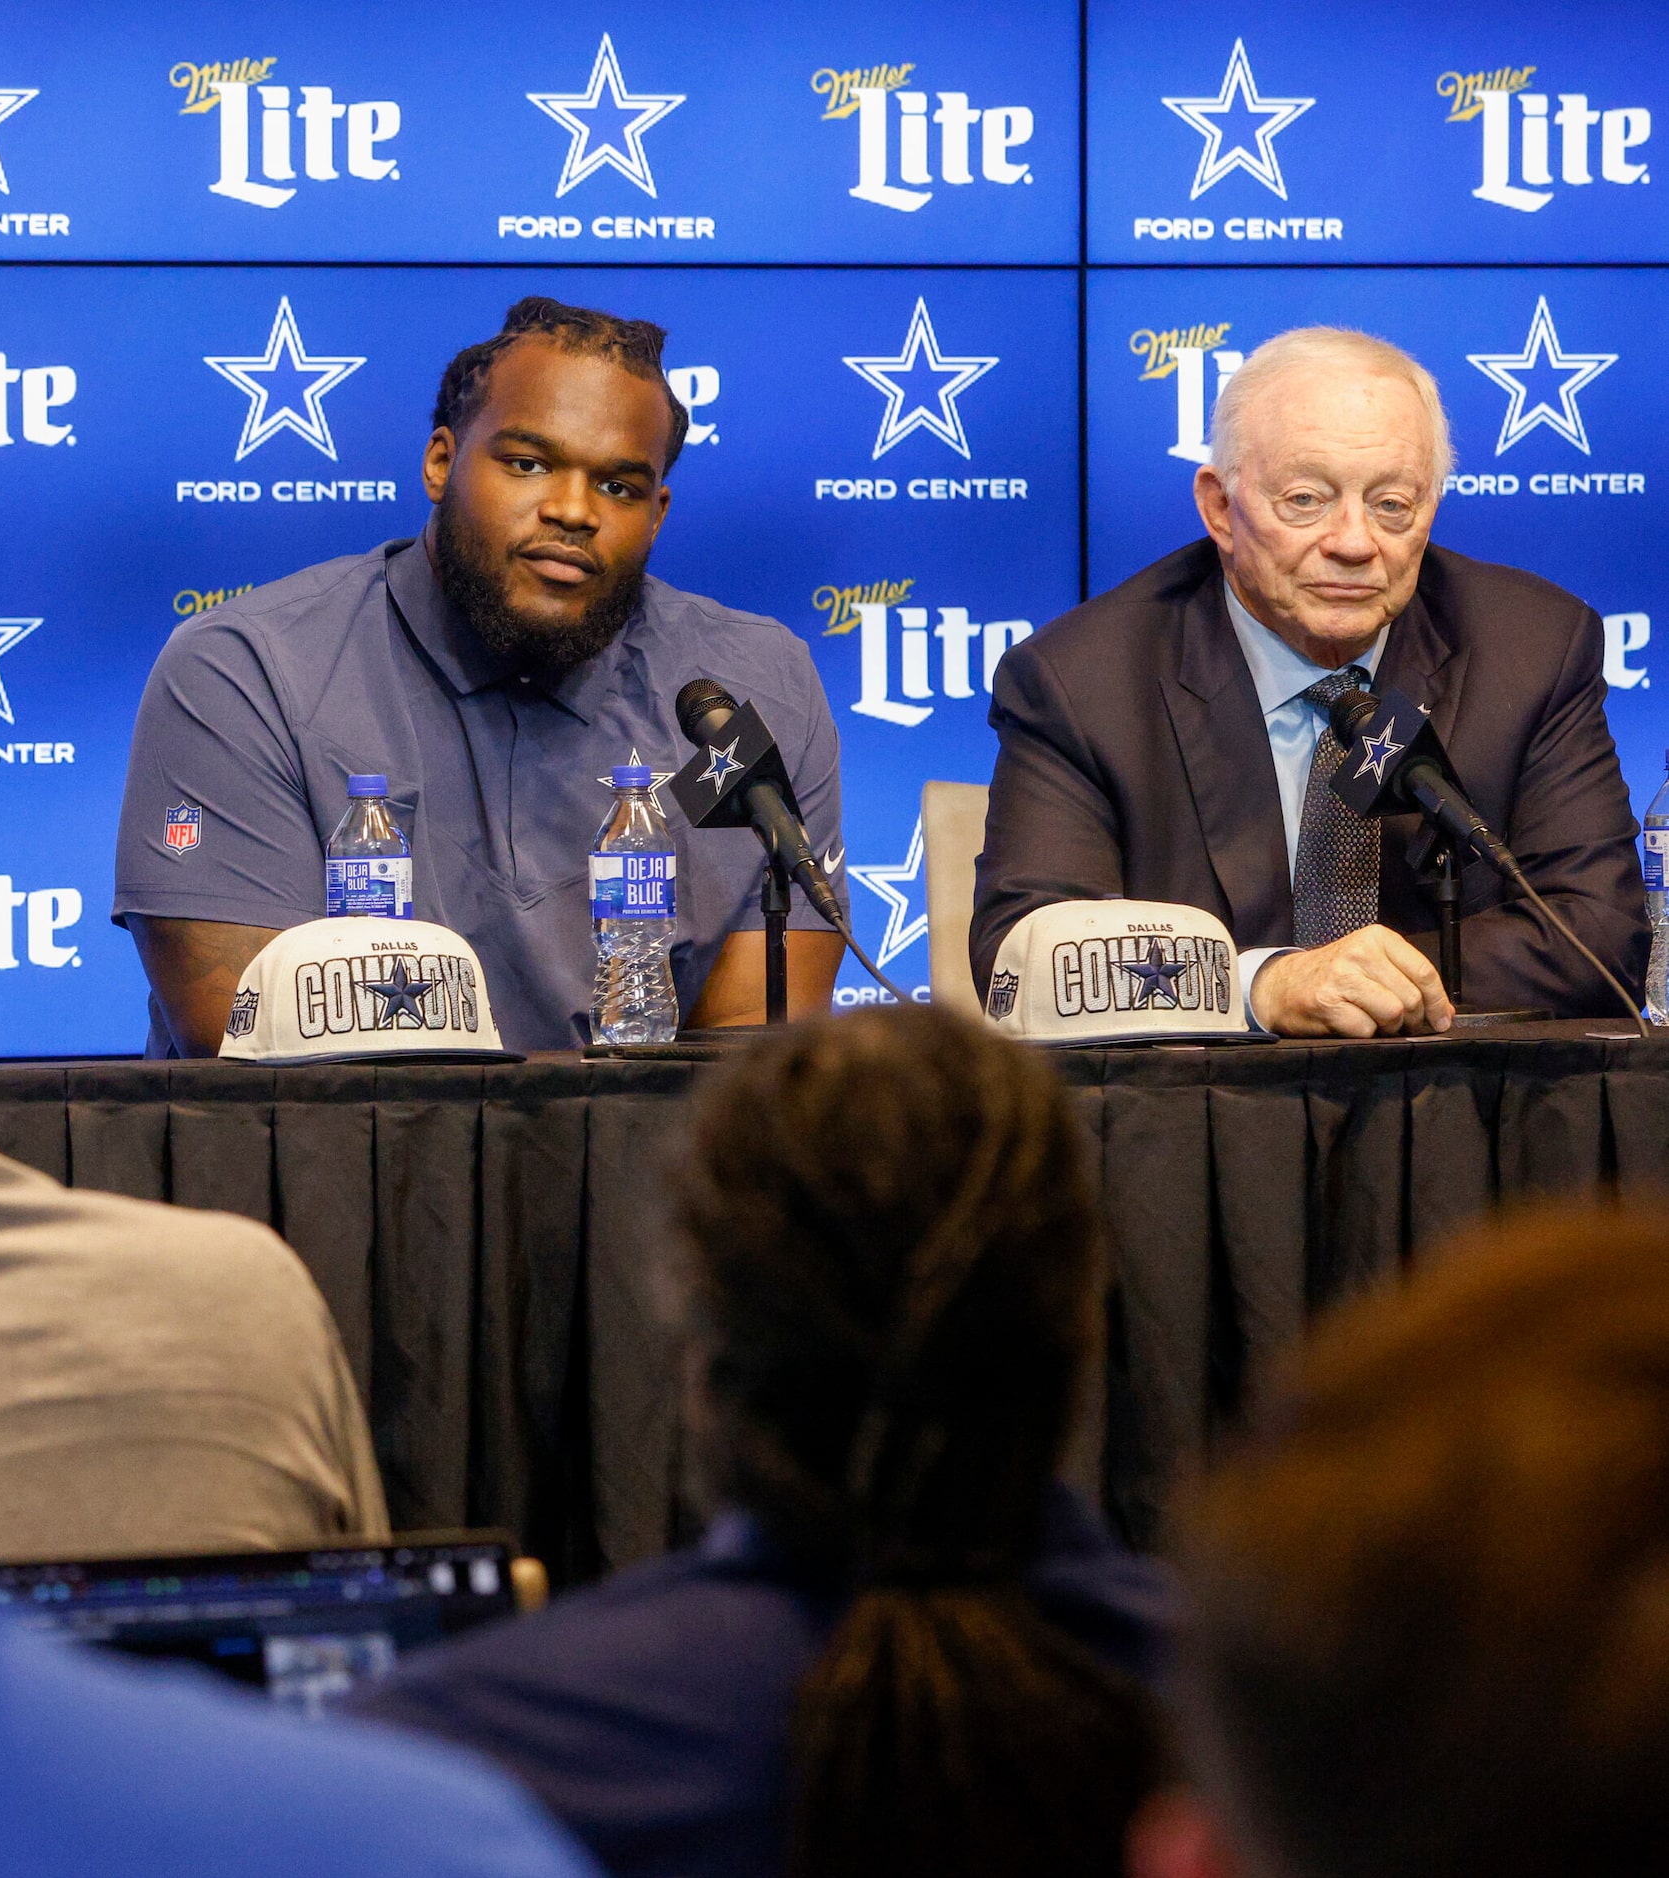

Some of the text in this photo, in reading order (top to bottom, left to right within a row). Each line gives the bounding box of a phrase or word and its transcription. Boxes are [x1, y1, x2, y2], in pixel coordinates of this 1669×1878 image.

[170, 57, 278, 114] Miller
[811, 63, 916, 120] Miller
[1437, 66, 1537, 123] Miller
[499, 216, 714, 238] FORD CENTER
[1134, 218, 1343, 240] FORD CENTER
[1130, 323, 1232, 381] Miller
[177, 482, 395, 501] FORD CENTER
[816, 480, 1026, 499] FORD CENTER
[1530, 475, 1644, 493] CENTER
[812, 577, 916, 636] Miller
[167, 824, 196, 847] NFL
[346, 864, 368, 877] DEJA
[627, 857, 664, 880] DEJA
[347, 878, 369, 890] BLUE
[627, 881, 664, 905] BLUE
[1127, 922, 1174, 932] DALLAS
[371, 941, 418, 951] DALLAS
[832, 987, 898, 1006] ORD
[990, 989, 1012, 1014] NFL
[228, 1007, 252, 1033] NFL
